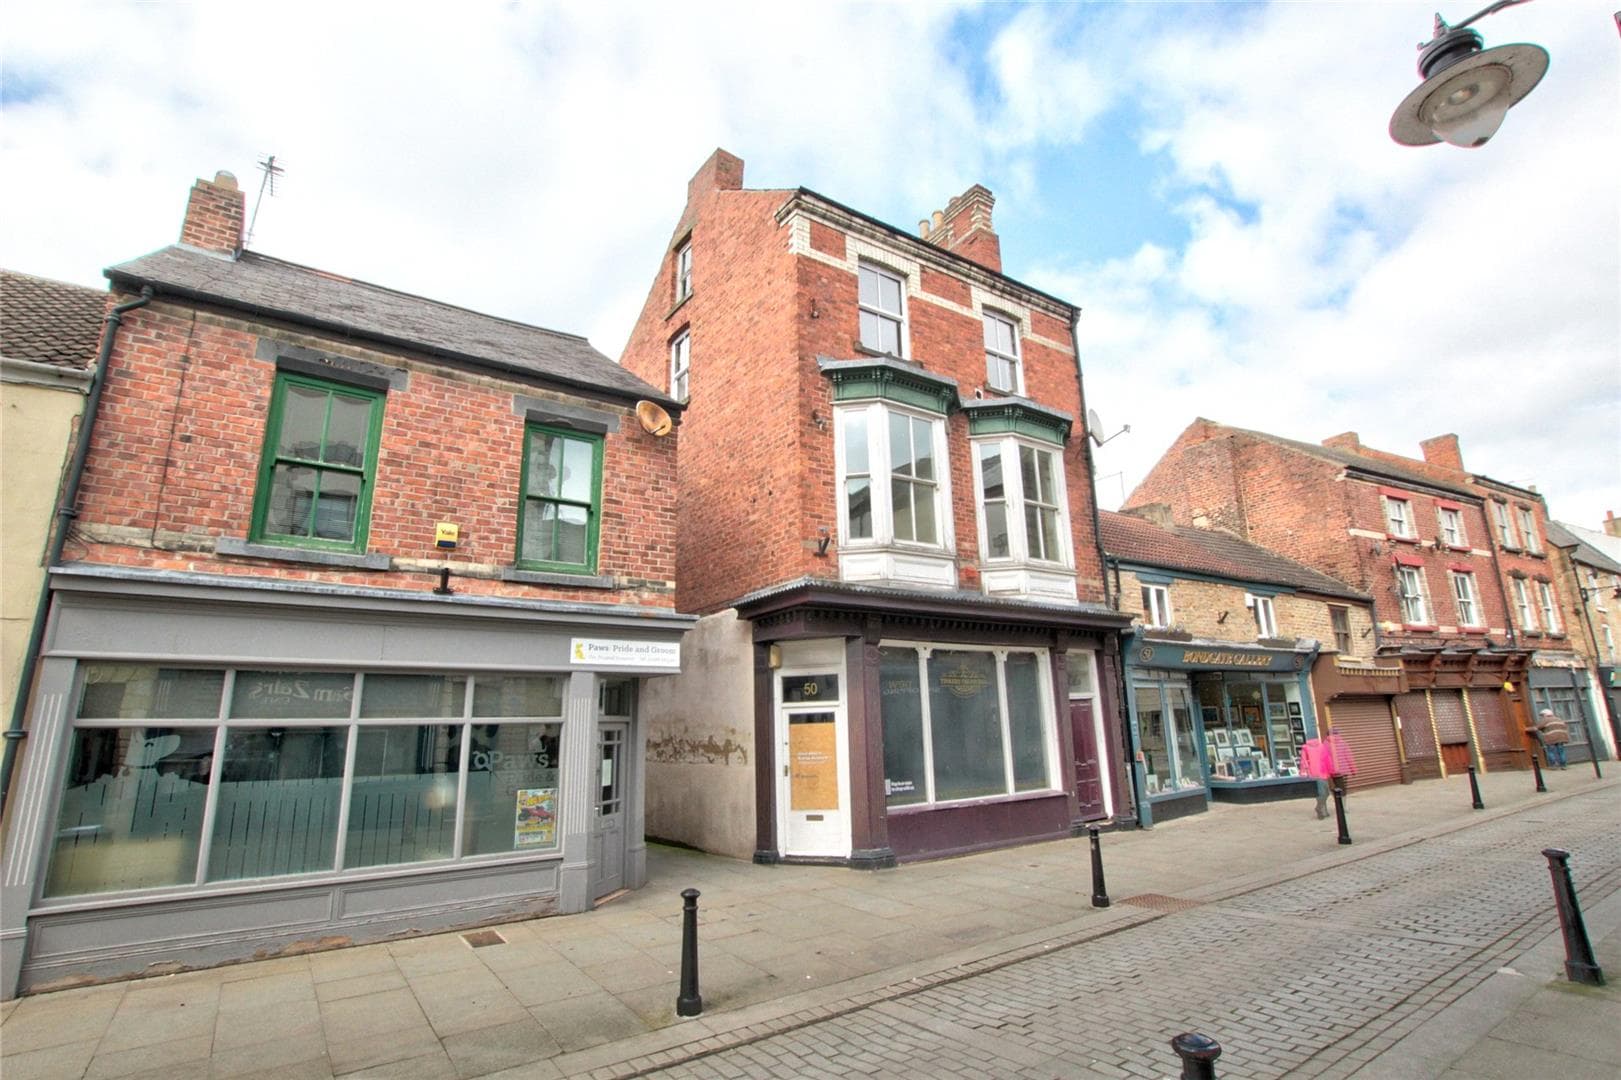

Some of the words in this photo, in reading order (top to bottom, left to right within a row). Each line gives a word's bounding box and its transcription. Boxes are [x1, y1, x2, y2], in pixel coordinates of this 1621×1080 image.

[612, 644, 634, 653] Pride
[635, 645, 650, 654] and
[804, 682, 817, 695] 50
